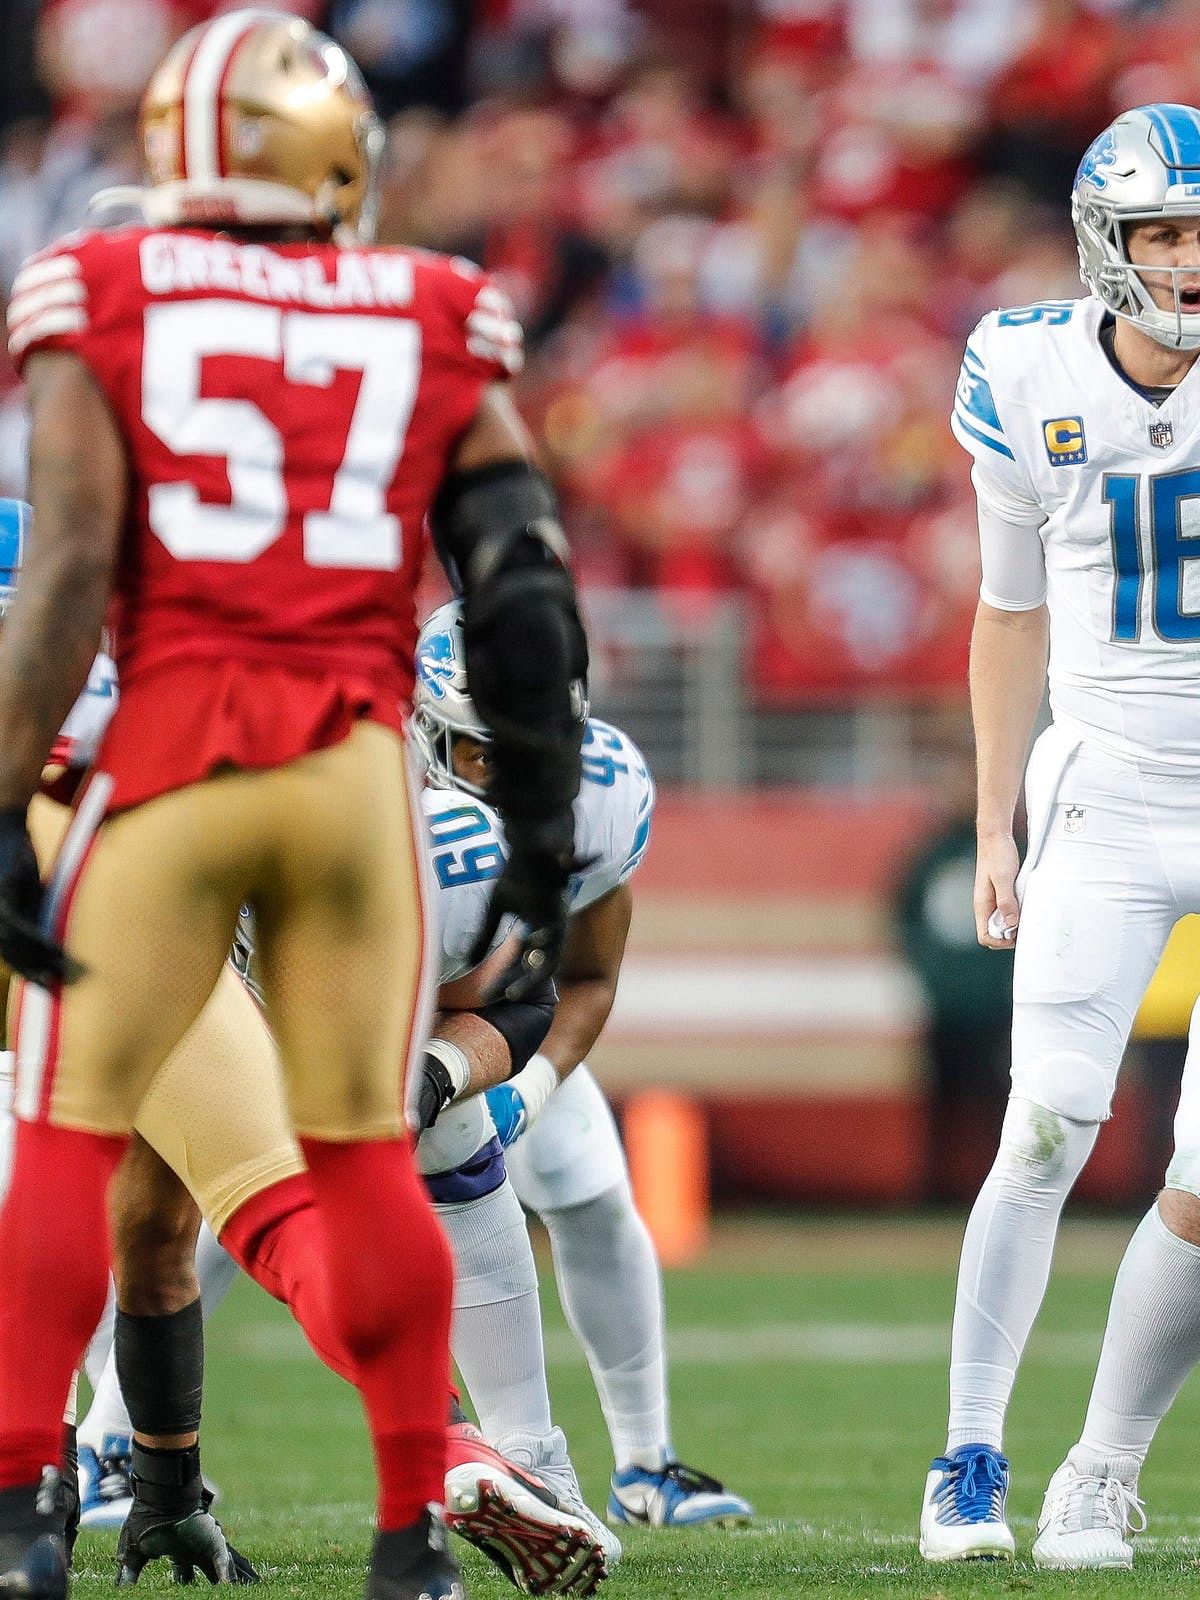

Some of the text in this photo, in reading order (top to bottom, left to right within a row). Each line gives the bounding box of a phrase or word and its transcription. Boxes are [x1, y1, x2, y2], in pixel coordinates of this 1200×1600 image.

[139, 232, 415, 308] GREENLAW
[142, 299, 421, 571] 57
[1044, 419, 1083, 454] C
[1152, 432, 1171, 446] NFL
[430, 805, 507, 890] 60
